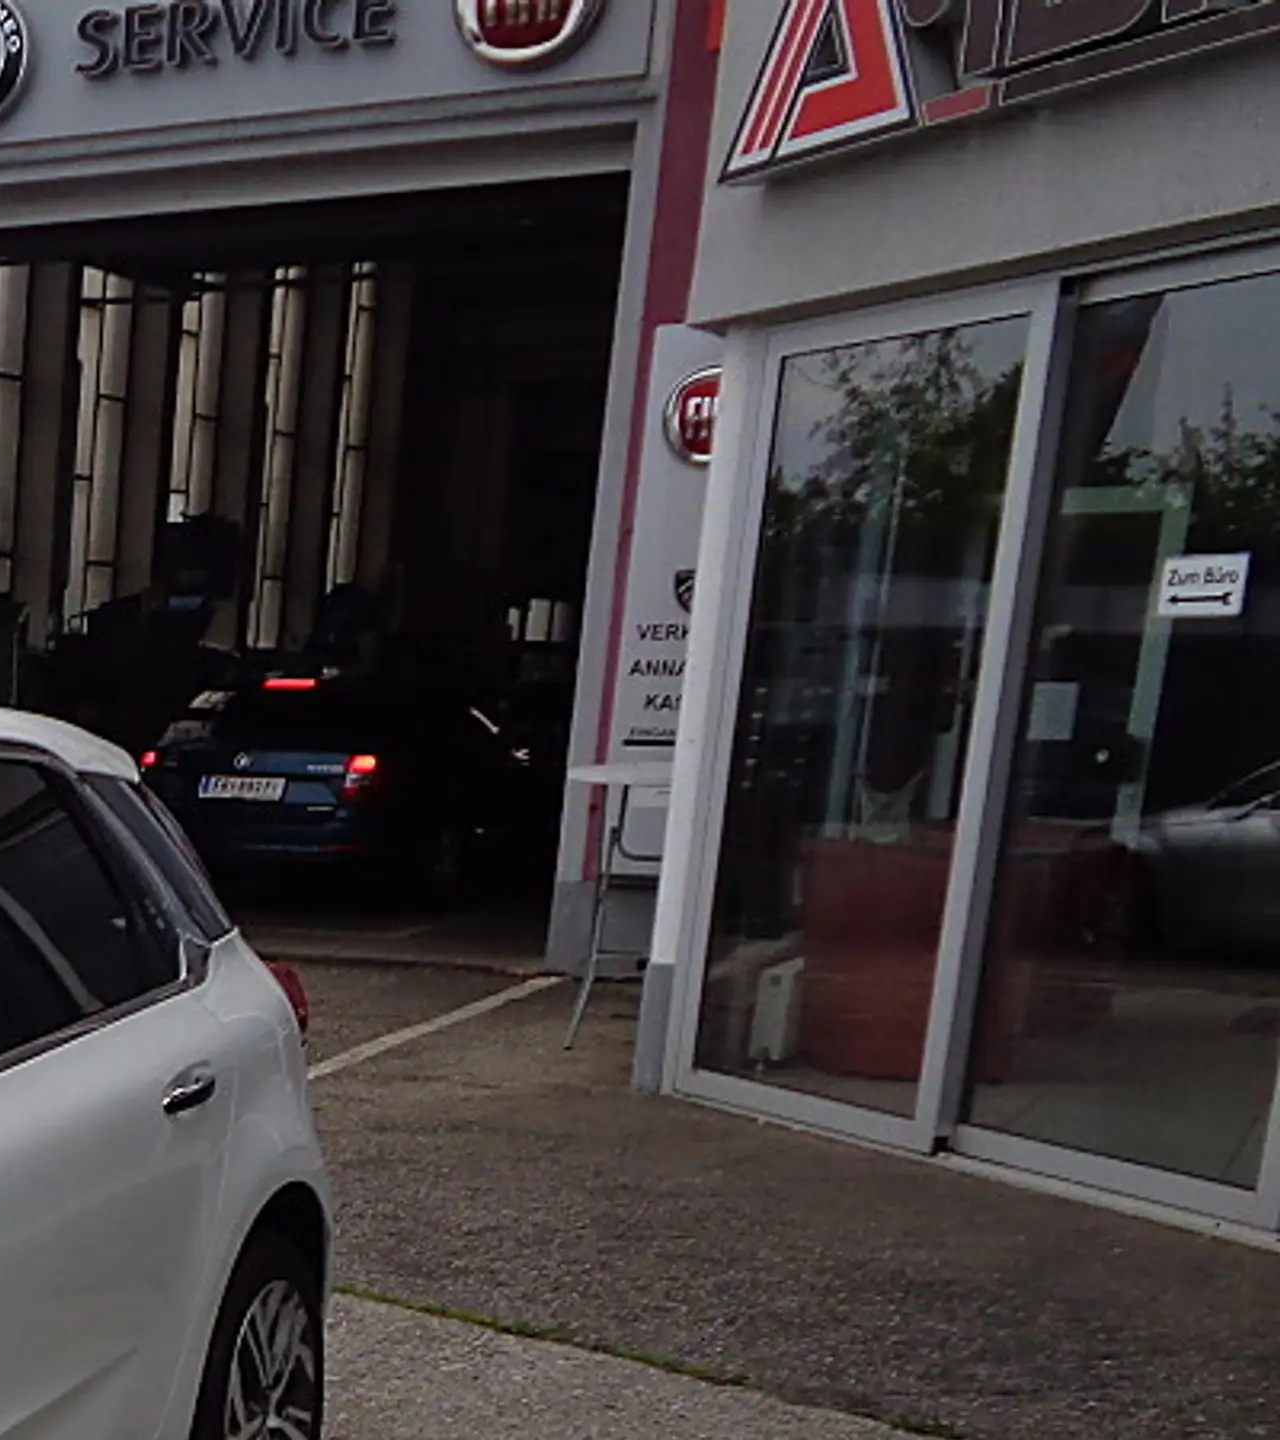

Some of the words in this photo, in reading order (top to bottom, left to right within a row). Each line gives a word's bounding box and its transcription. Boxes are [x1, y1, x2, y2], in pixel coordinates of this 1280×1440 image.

[75, 0, 397, 80] SERVICE
[1167, 569, 1201, 586] Zum
[1203, 566, 1240, 584] Büro
